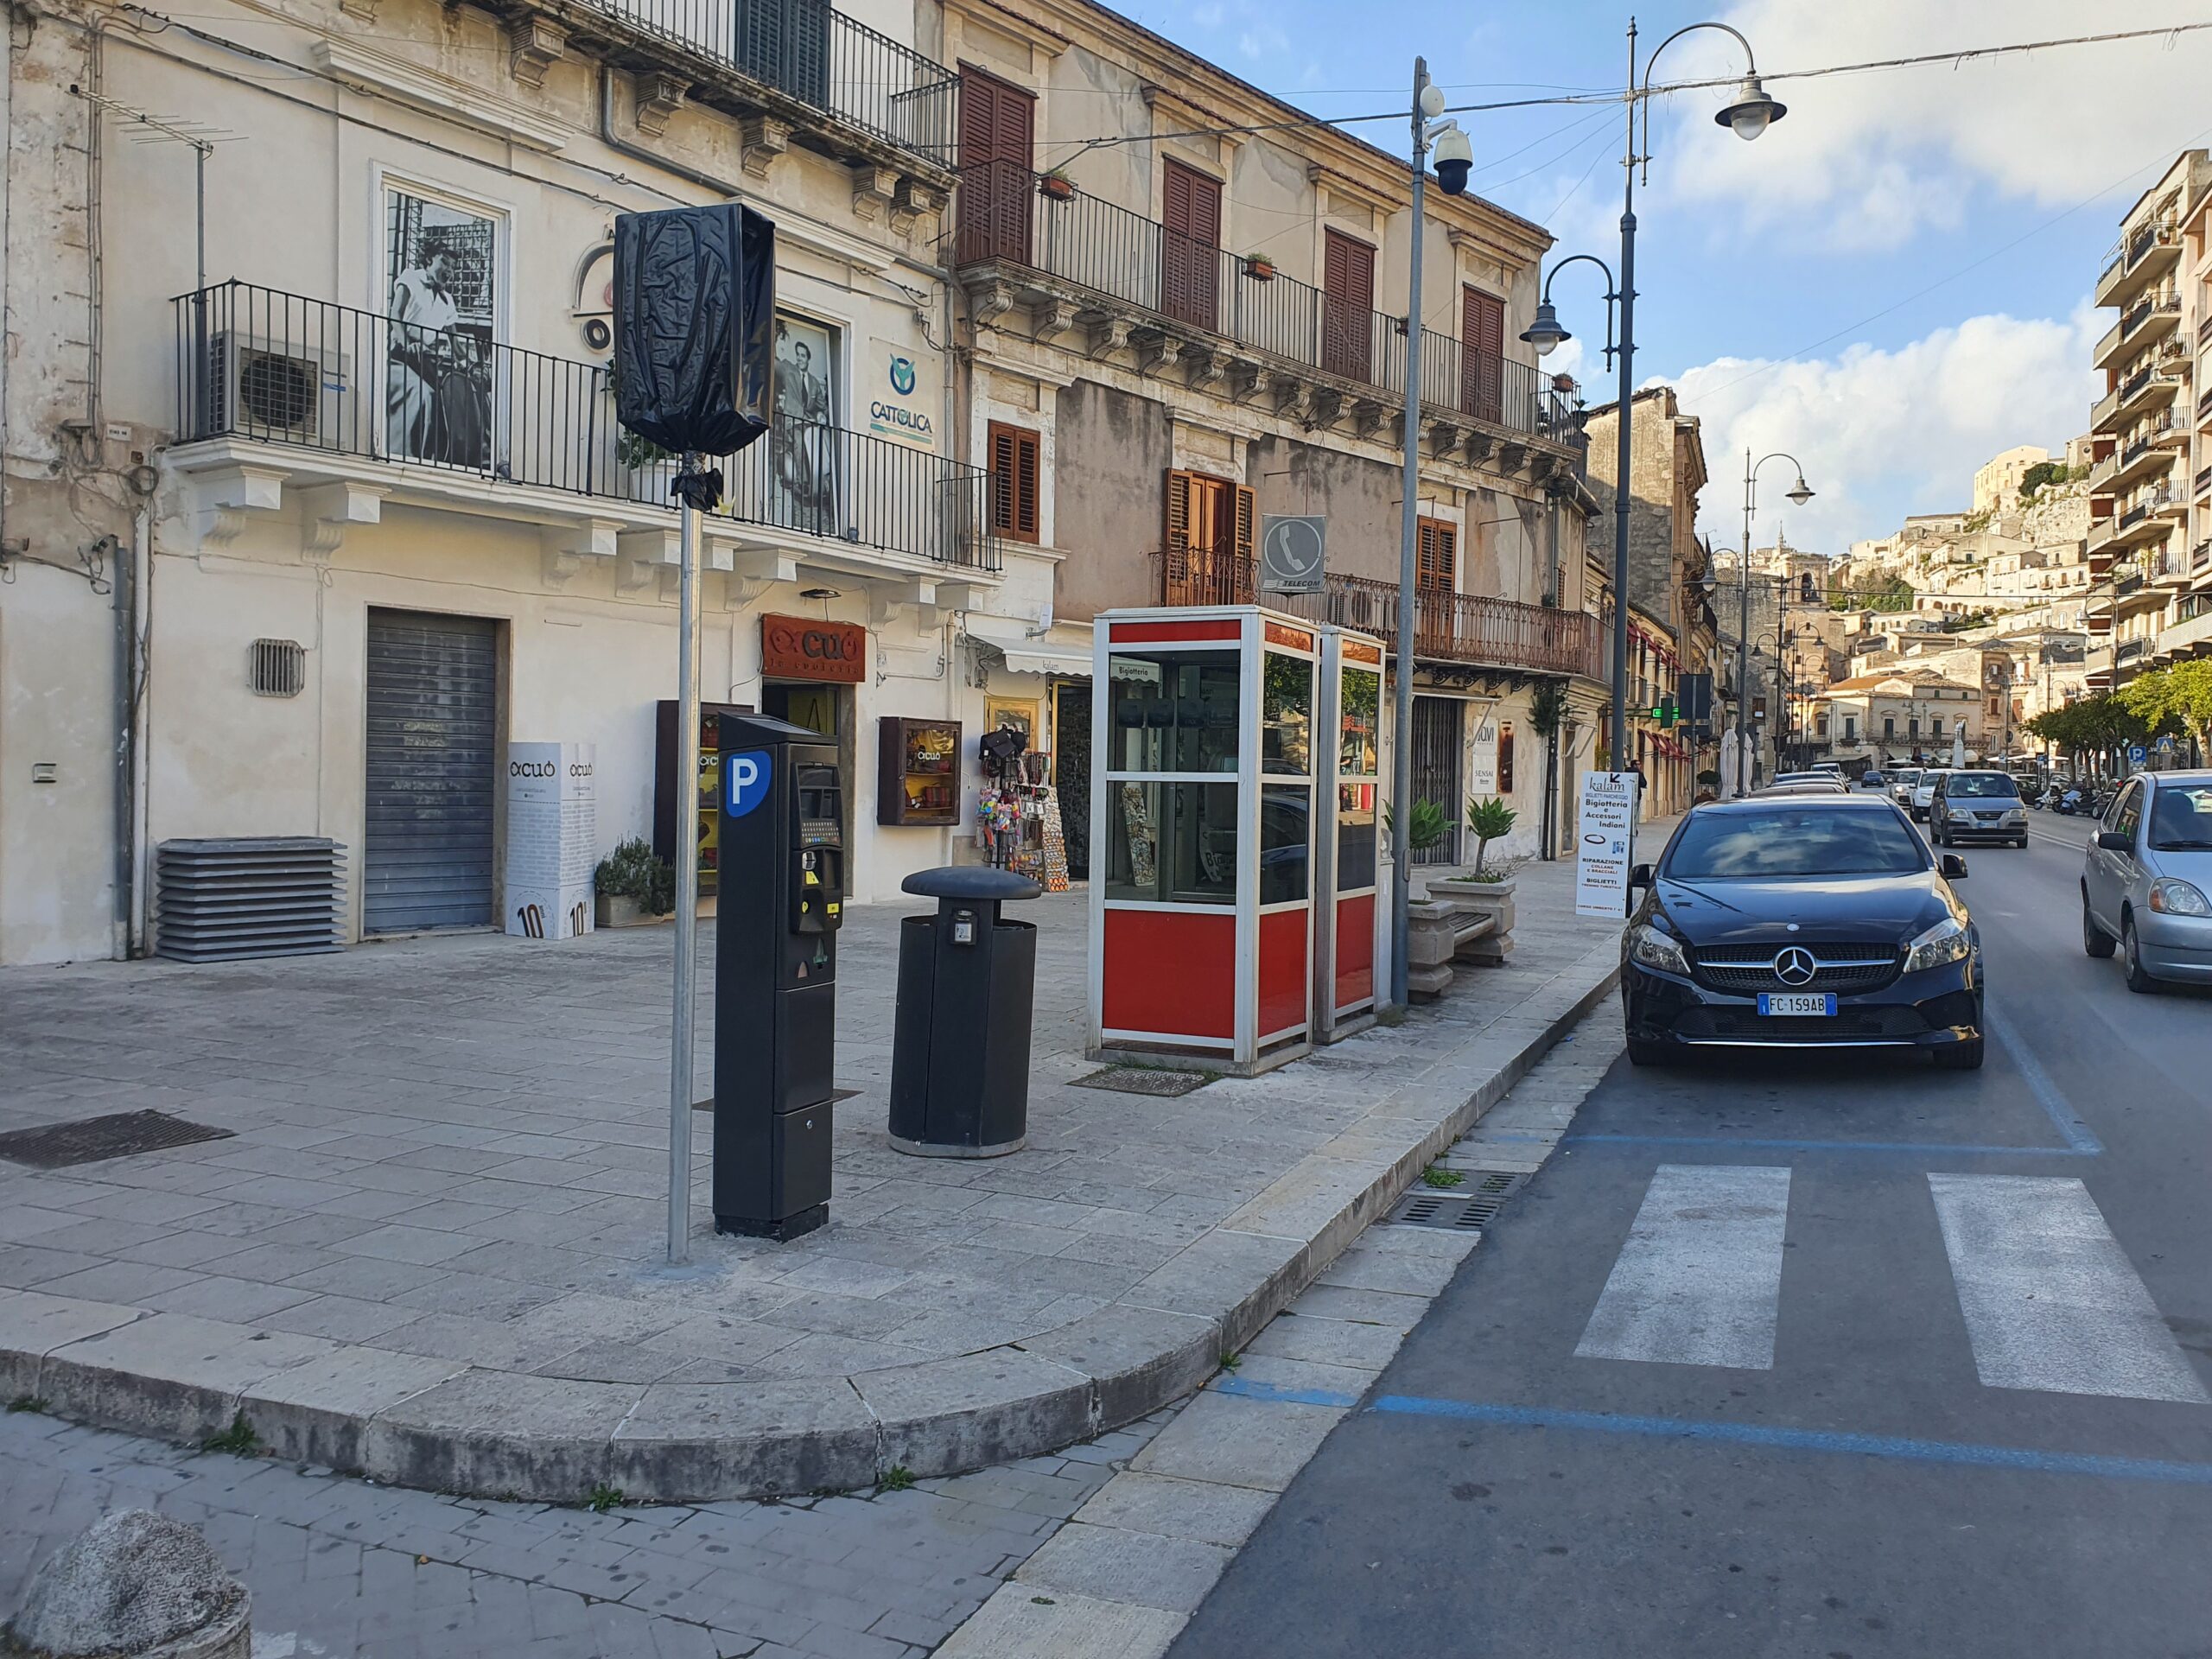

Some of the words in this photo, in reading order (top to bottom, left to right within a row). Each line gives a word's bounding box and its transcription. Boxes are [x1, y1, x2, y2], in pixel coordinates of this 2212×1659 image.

[871, 401, 933, 434] CATTOLICA
[1118, 665, 1148, 677] Bigiotteria
[2133, 748, 2143, 760] P
[732, 758, 759, 805] P
[1589, 777, 1625, 792] kalam
[1586, 798, 1628, 808] Bigiotteria
[1599, 821, 1625, 830] Indiani
